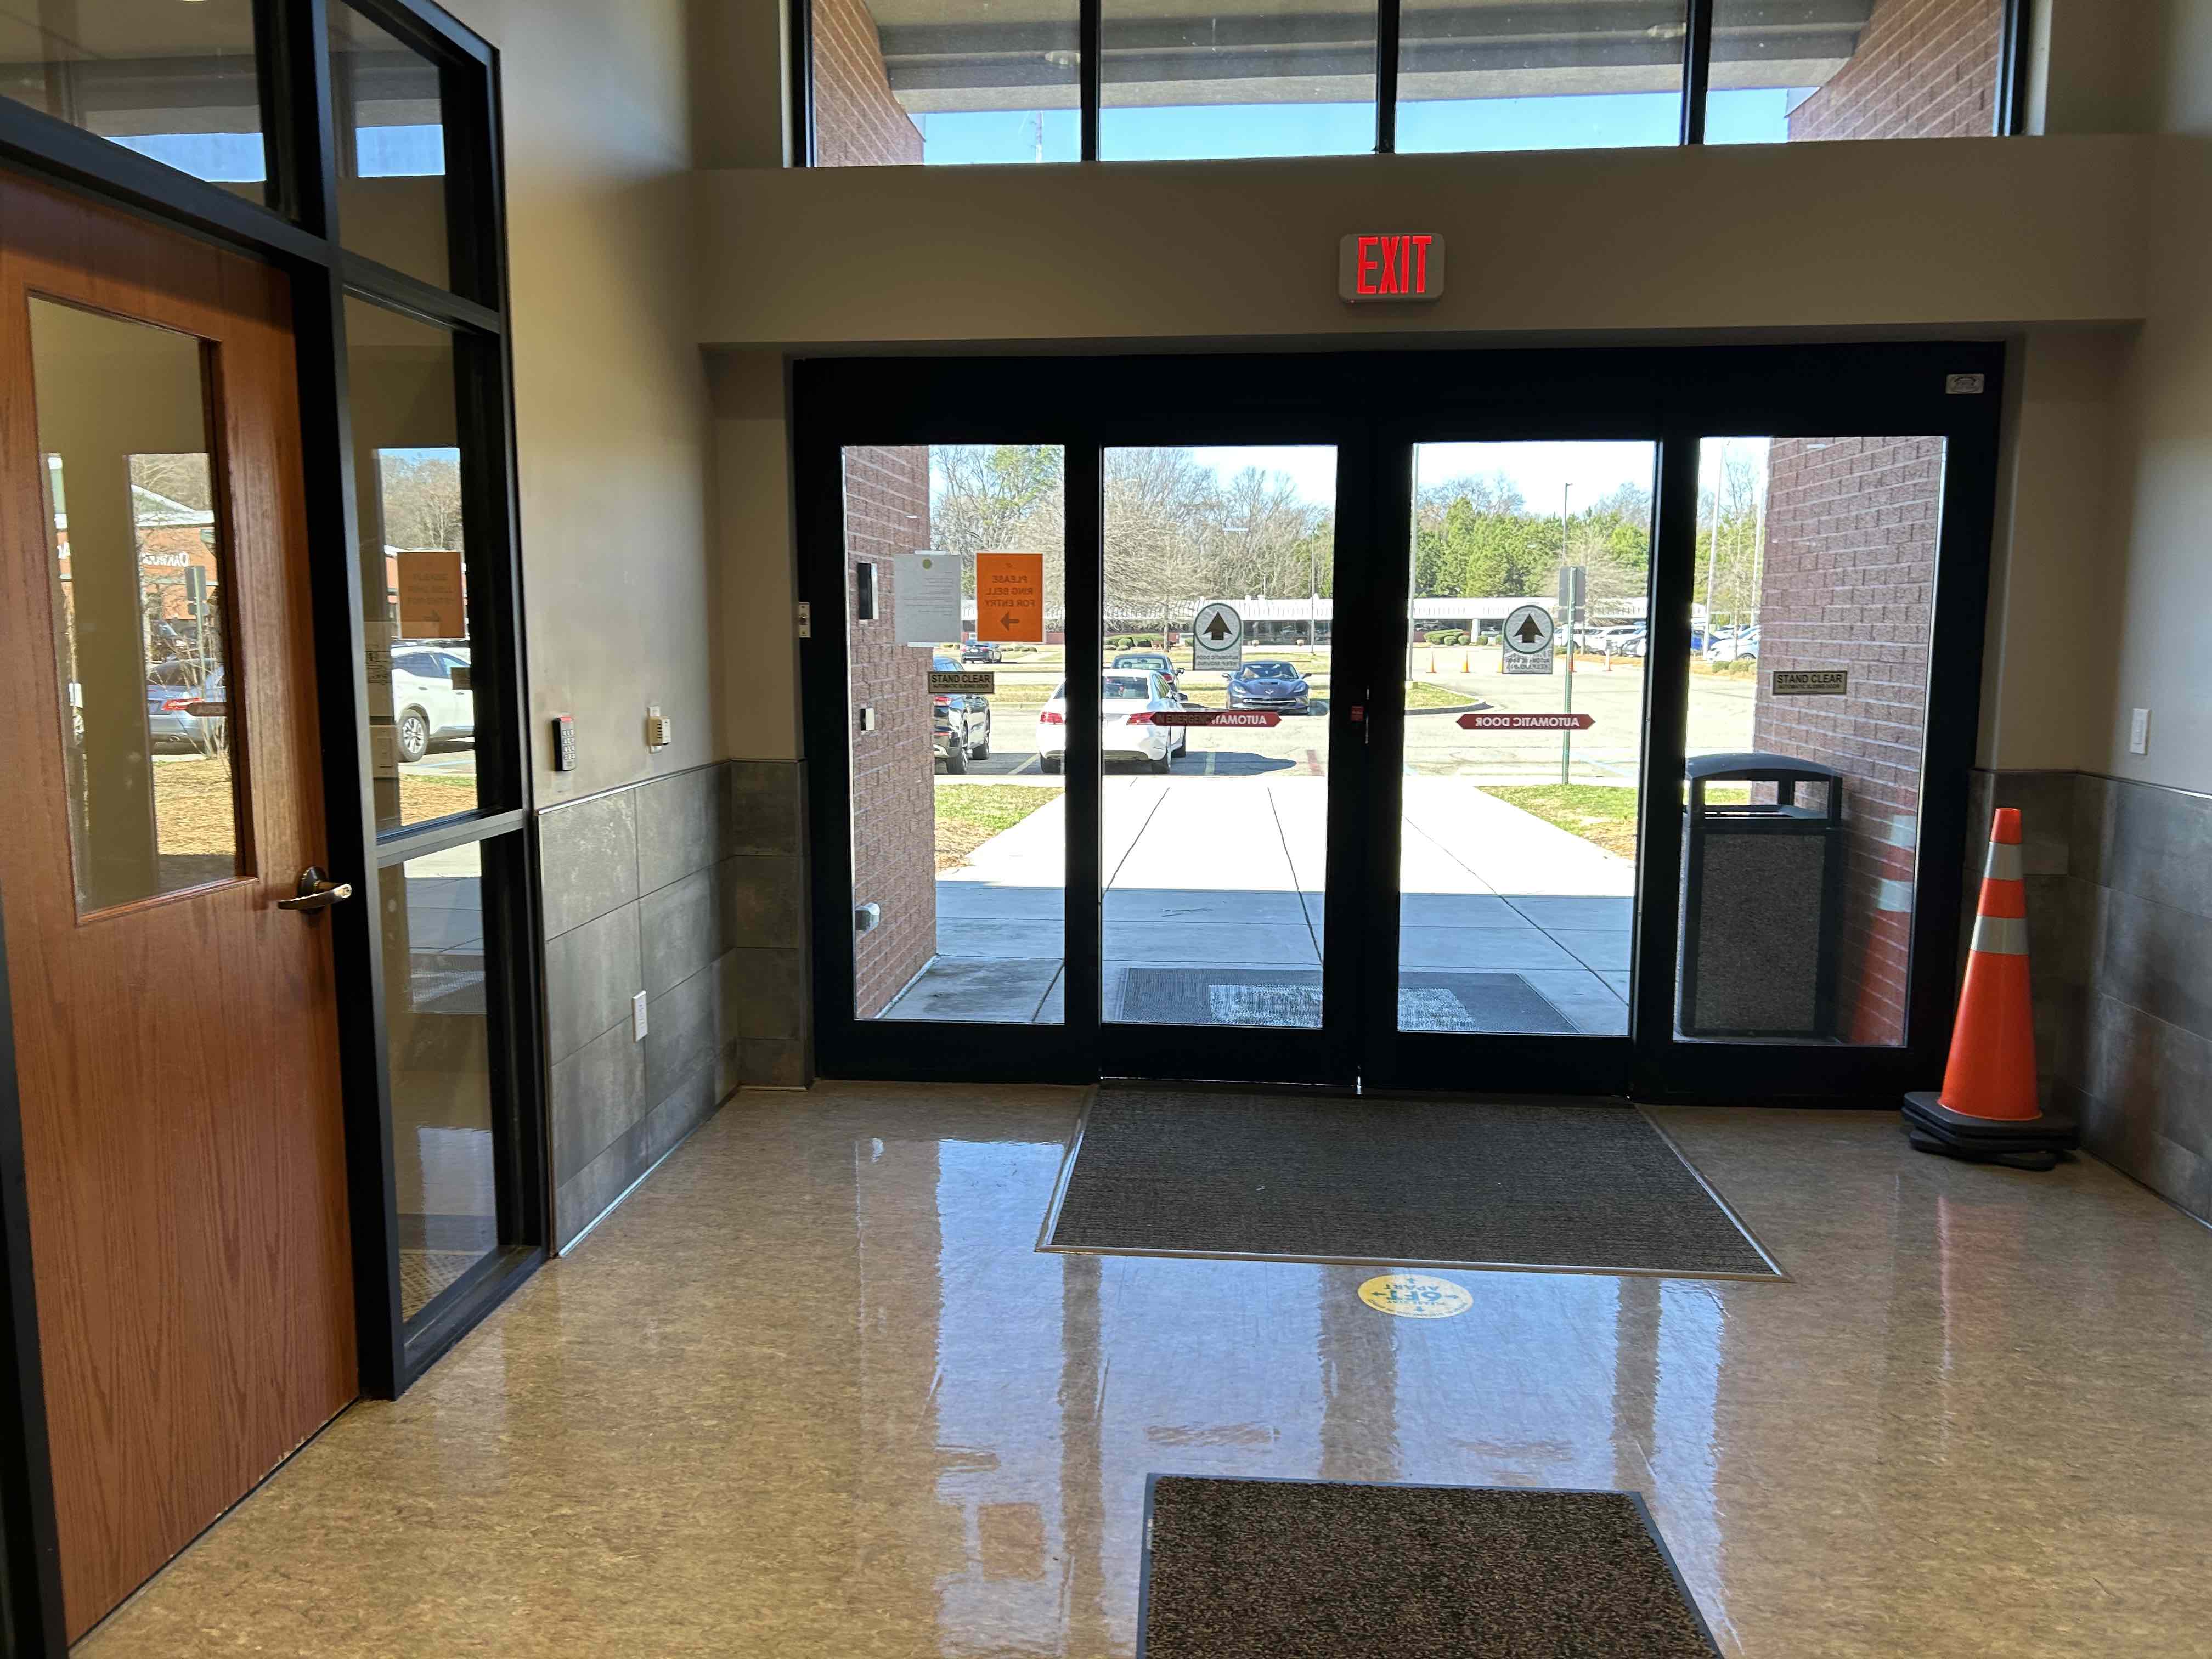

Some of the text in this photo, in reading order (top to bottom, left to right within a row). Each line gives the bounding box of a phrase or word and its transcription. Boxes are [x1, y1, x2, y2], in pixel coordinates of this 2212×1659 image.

[1357, 235, 1432, 294] EXIT
[932, 674, 990, 683] STAND CLEAR
[1777, 674, 1842, 684] STAND CLEAR
